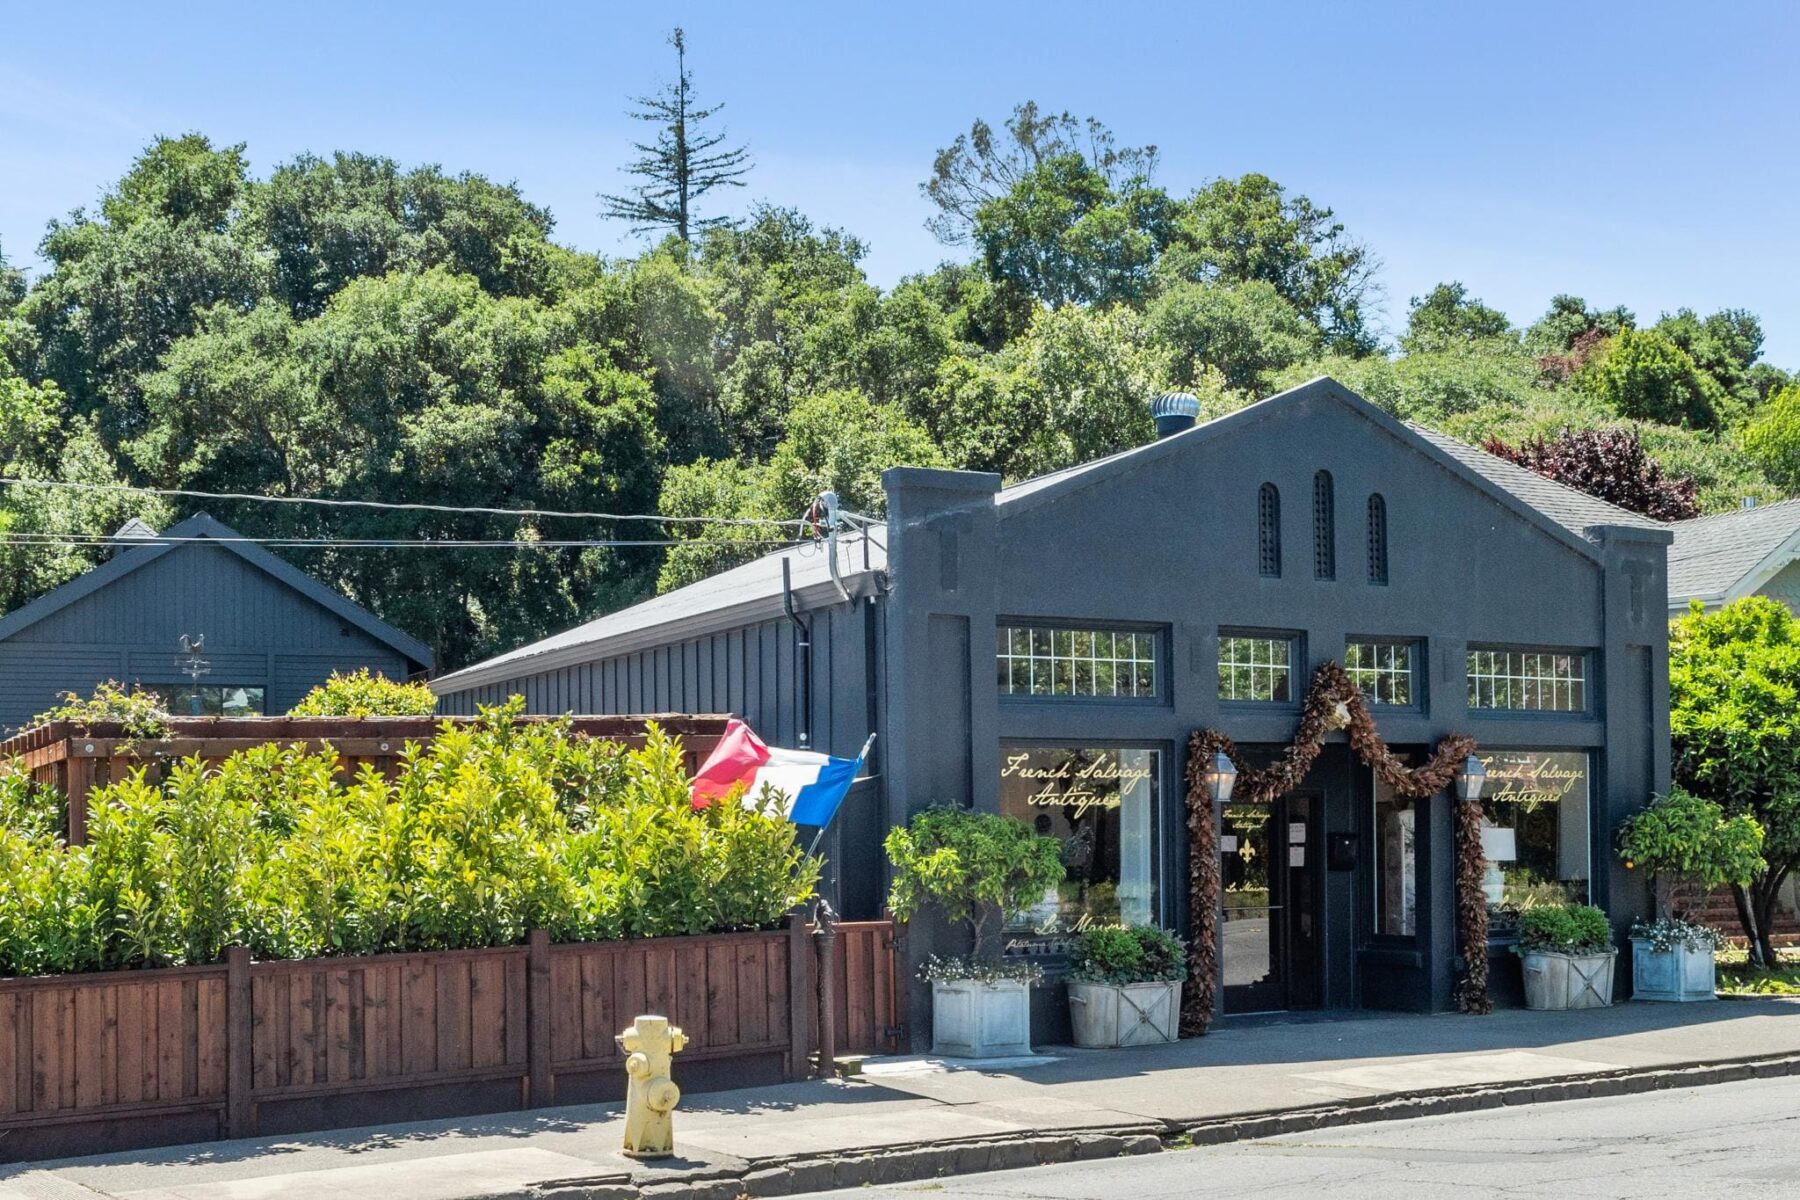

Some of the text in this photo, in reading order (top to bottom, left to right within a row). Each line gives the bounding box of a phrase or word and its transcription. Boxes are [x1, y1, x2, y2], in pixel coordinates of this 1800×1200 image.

[1001, 753, 1153, 794] French Salvage
[1527, 757, 1585, 793] Salvage
[1027, 782, 1121, 819] Antiques
[1492, 782, 1562, 814] Antiques
[1225, 881, 1270, 893] La Maison
[1492, 894, 1512, 913] La
[1034, 913, 1060, 935] La
